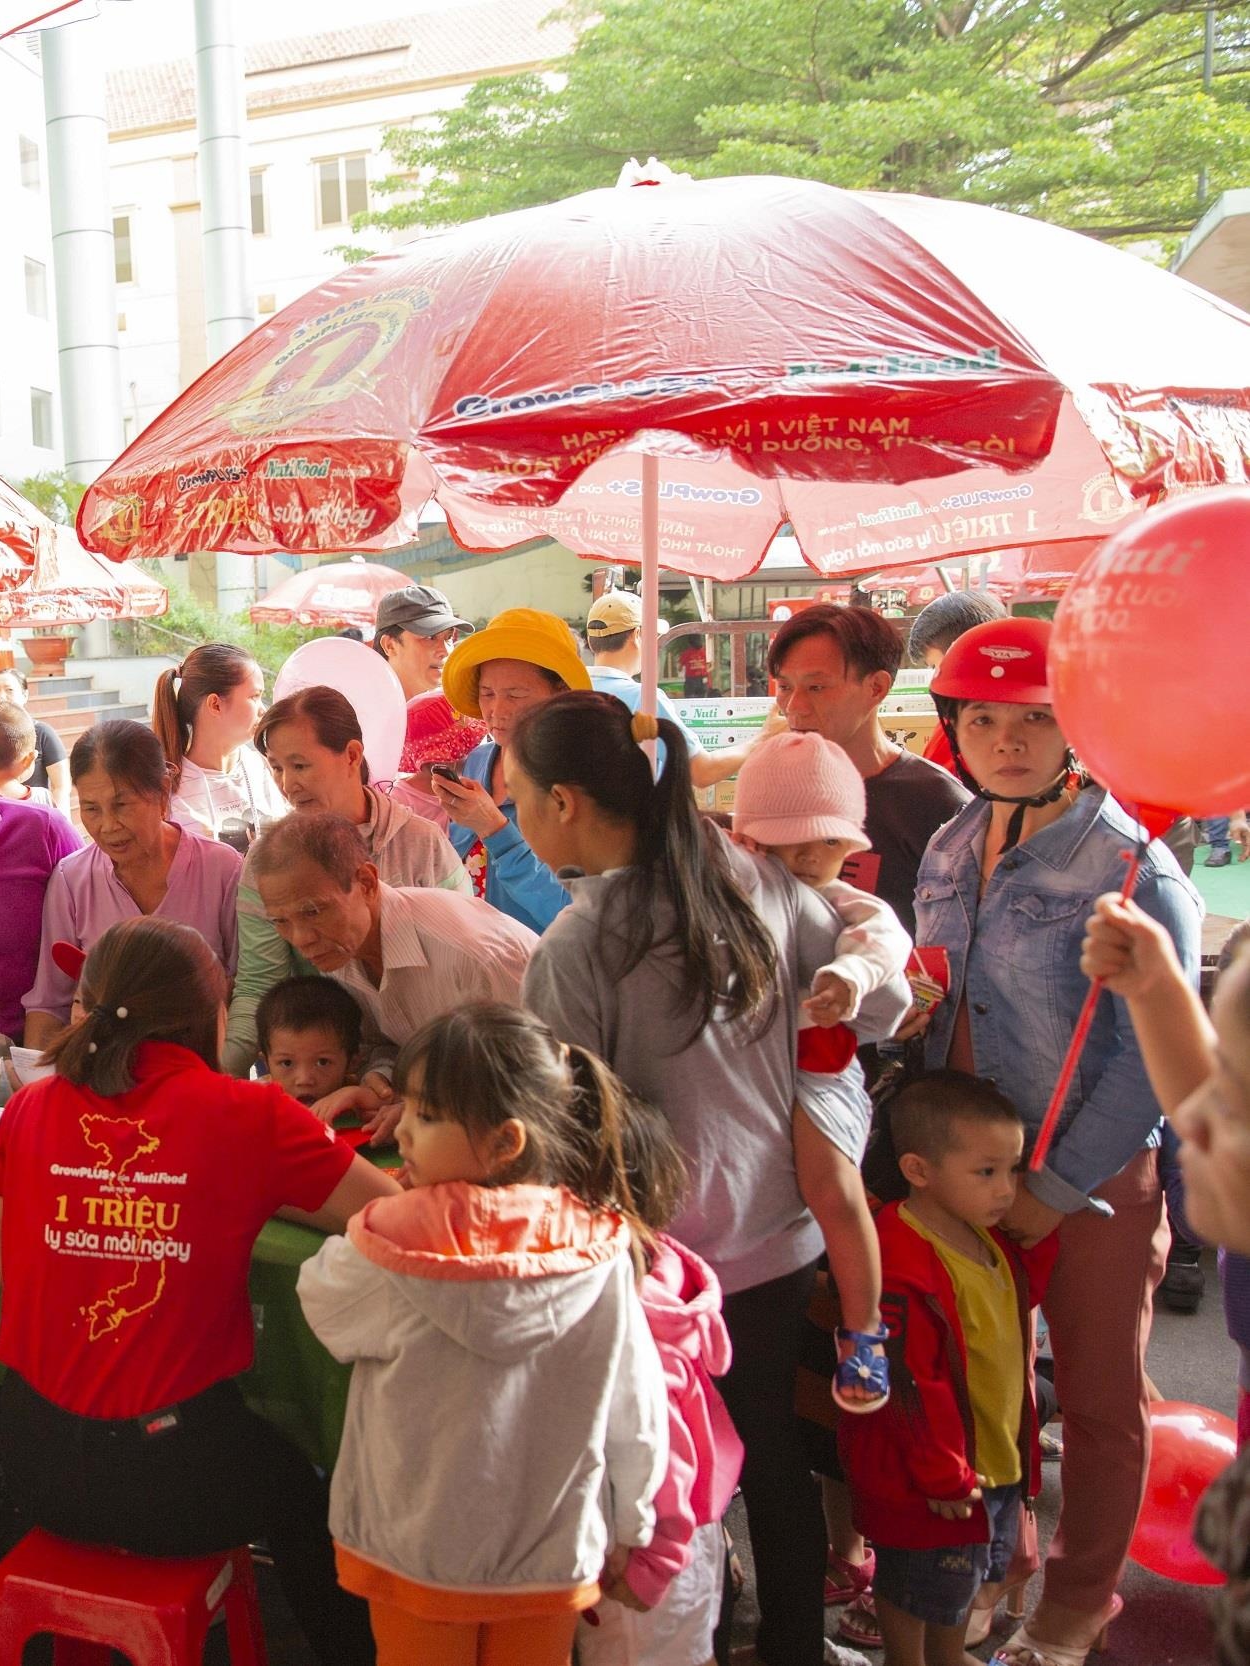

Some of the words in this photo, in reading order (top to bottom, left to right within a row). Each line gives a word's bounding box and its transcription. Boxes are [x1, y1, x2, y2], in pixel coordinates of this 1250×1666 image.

[778, 412, 839, 436] VIỆT
[848, 417, 911, 435] NAM
[693, 708, 719, 719] Nuti
[50, 1163, 116, 1181] GrowPLUS+
[132, 1171, 188, 1185] NutiFood
[54, 1194, 69, 1223] 1
[44, 1224, 61, 1251] ly
[103, 1230, 137, 1254] mỗi
[140, 1235, 191, 1264] ngày
